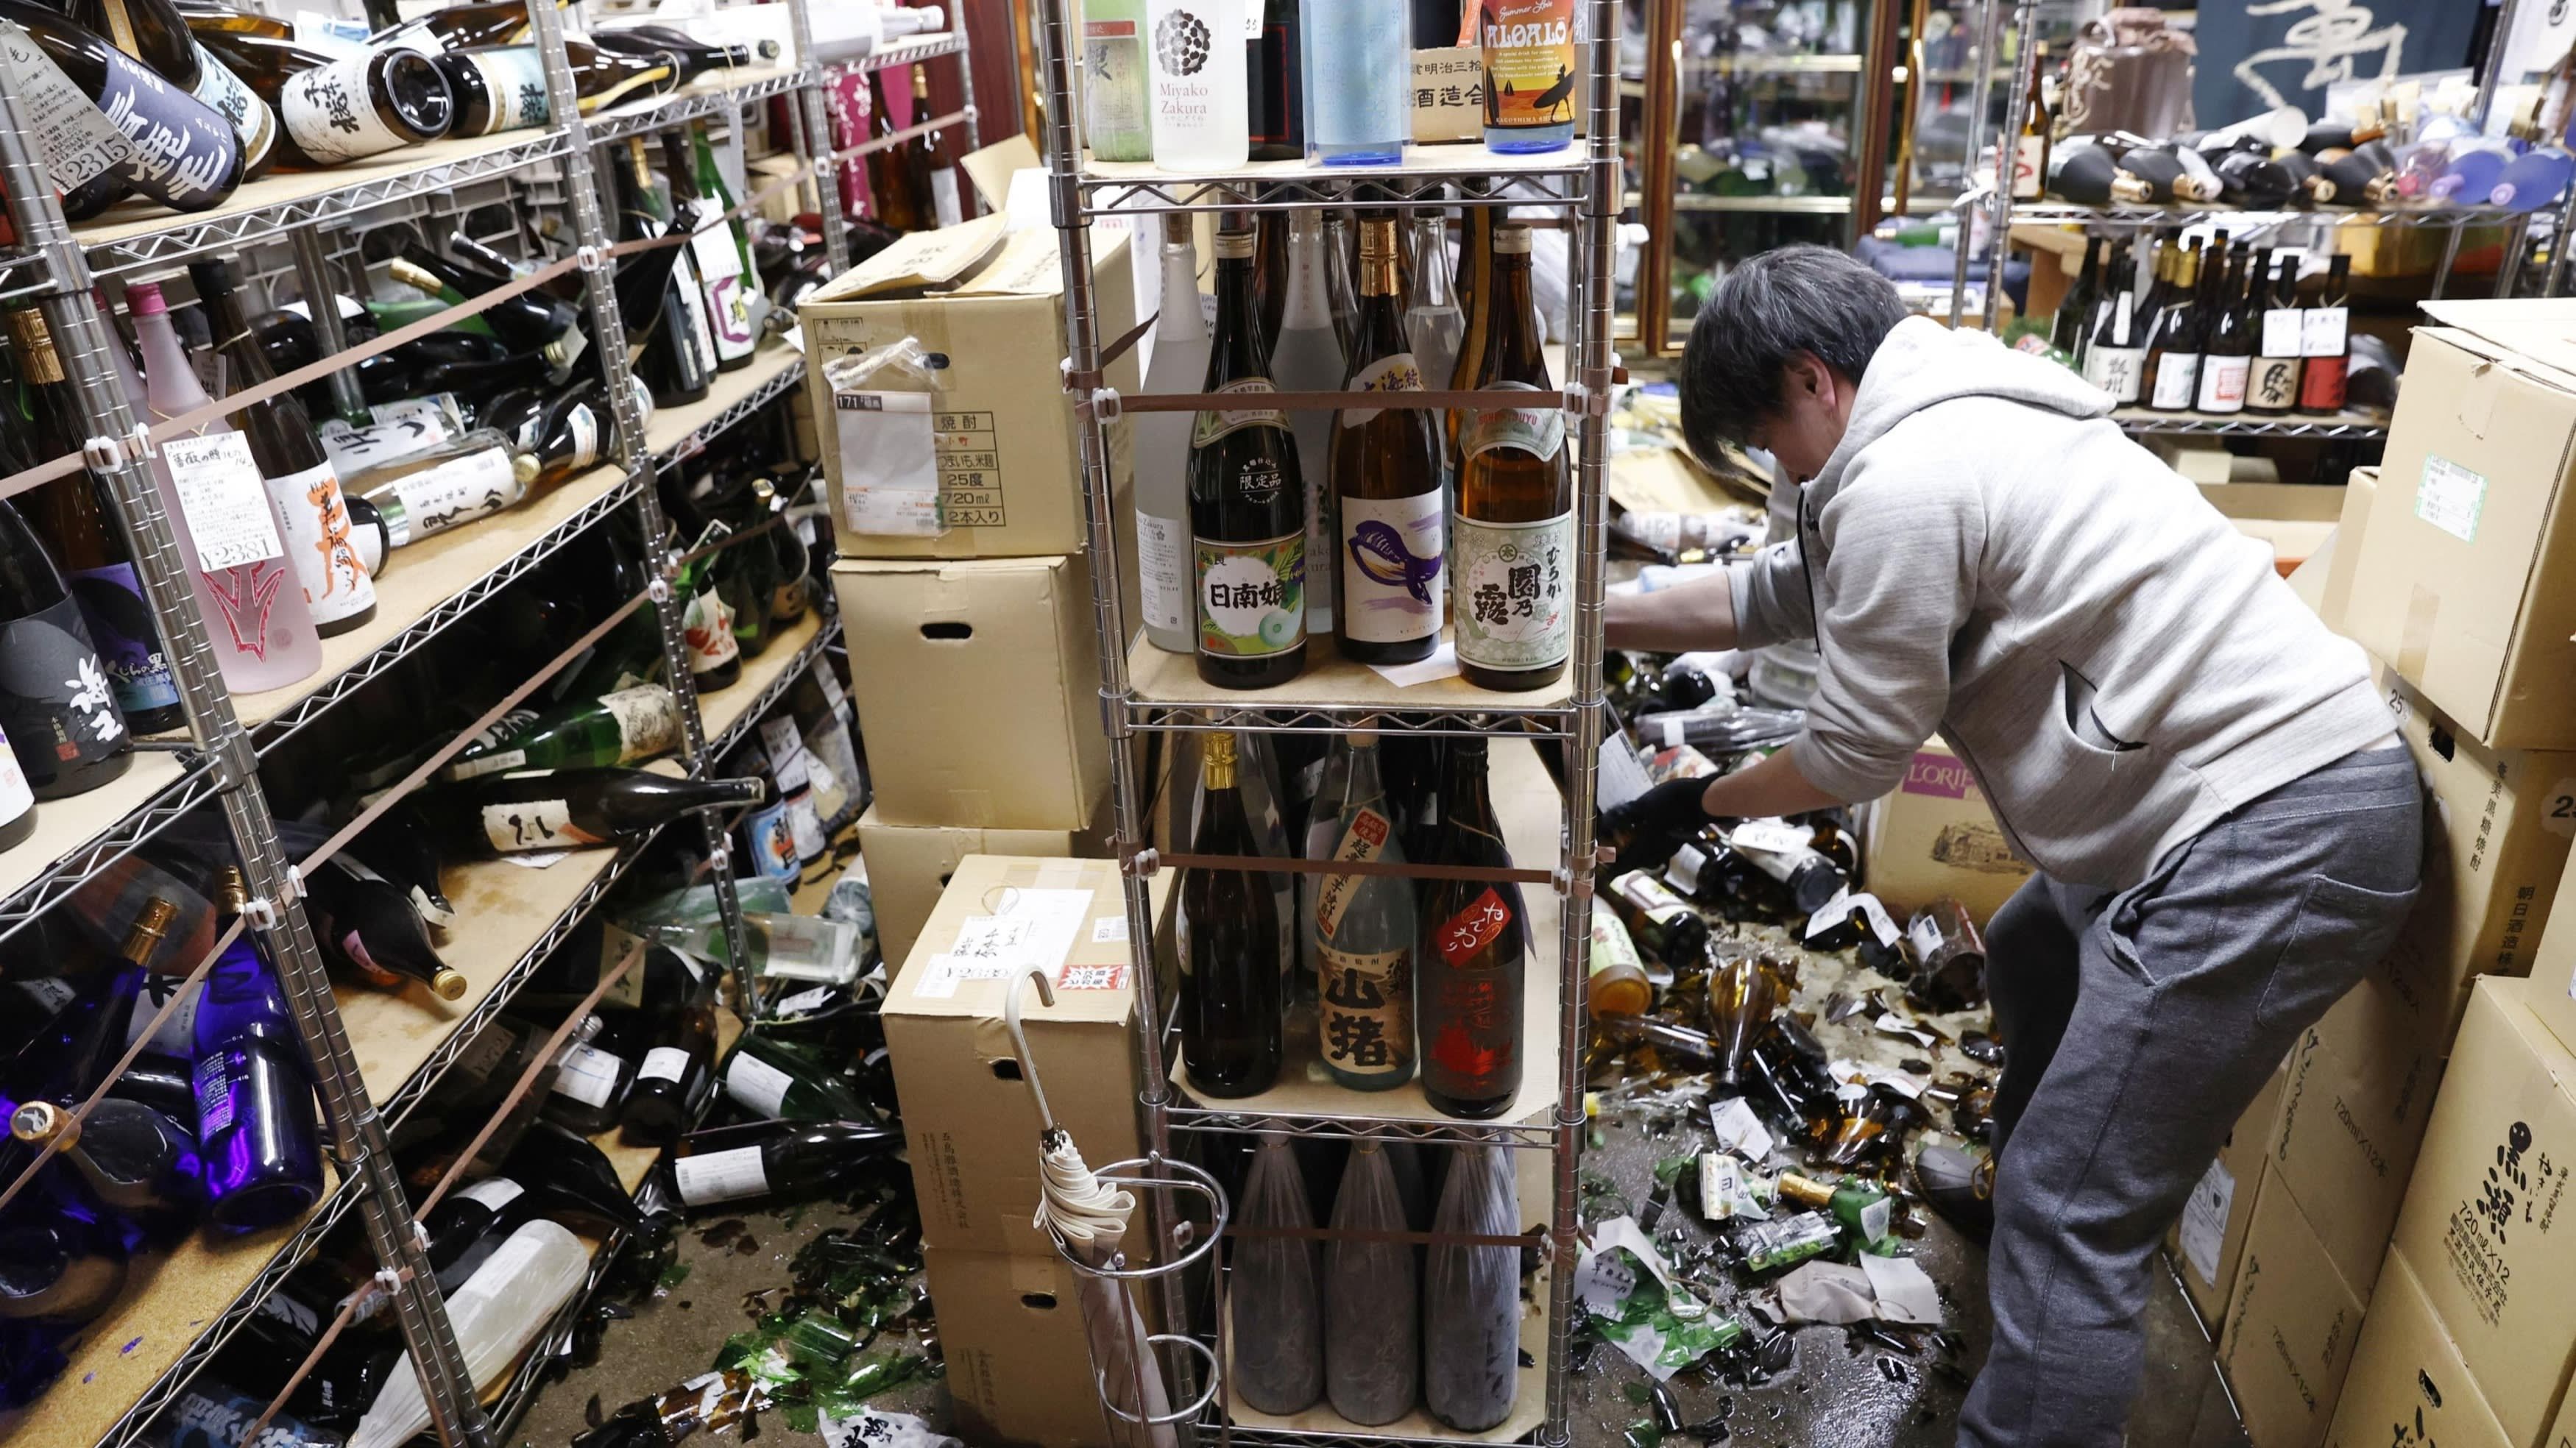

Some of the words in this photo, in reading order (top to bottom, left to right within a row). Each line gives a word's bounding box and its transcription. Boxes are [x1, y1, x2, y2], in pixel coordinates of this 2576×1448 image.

[1499, 6, 1531, 22] Summer
[1160, 82, 1208, 100] Miyako
[1161, 101, 1207, 114] Zakura
[838, 396, 857, 408] 171
[941, 415, 977, 430] 焼酎
[947, 473, 983, 487] 25度
[1239, 474, 1281, 490] 限定品
[1546, 547, 1561, 599] むろか
[1211, 581, 1288, 609] 日南娘
[2469, 761, 2508, 873] 奄美黒糖焼酎
[1326, 968, 1388, 1066] 山猪
